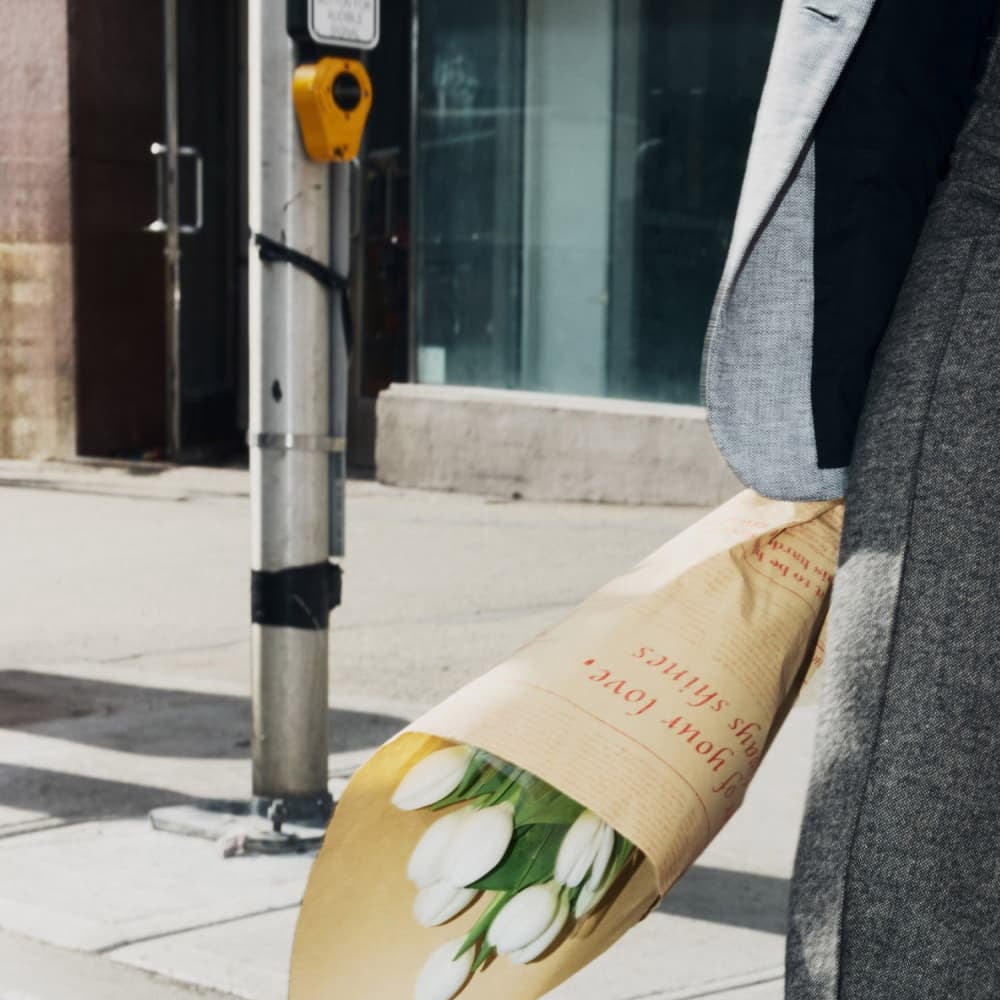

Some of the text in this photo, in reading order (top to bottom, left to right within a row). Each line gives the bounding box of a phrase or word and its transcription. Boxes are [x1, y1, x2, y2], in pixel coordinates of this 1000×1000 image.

[631, 647, 729, 712] shines
[660, 716, 735, 772] your
[712, 771, 744, 799] of
